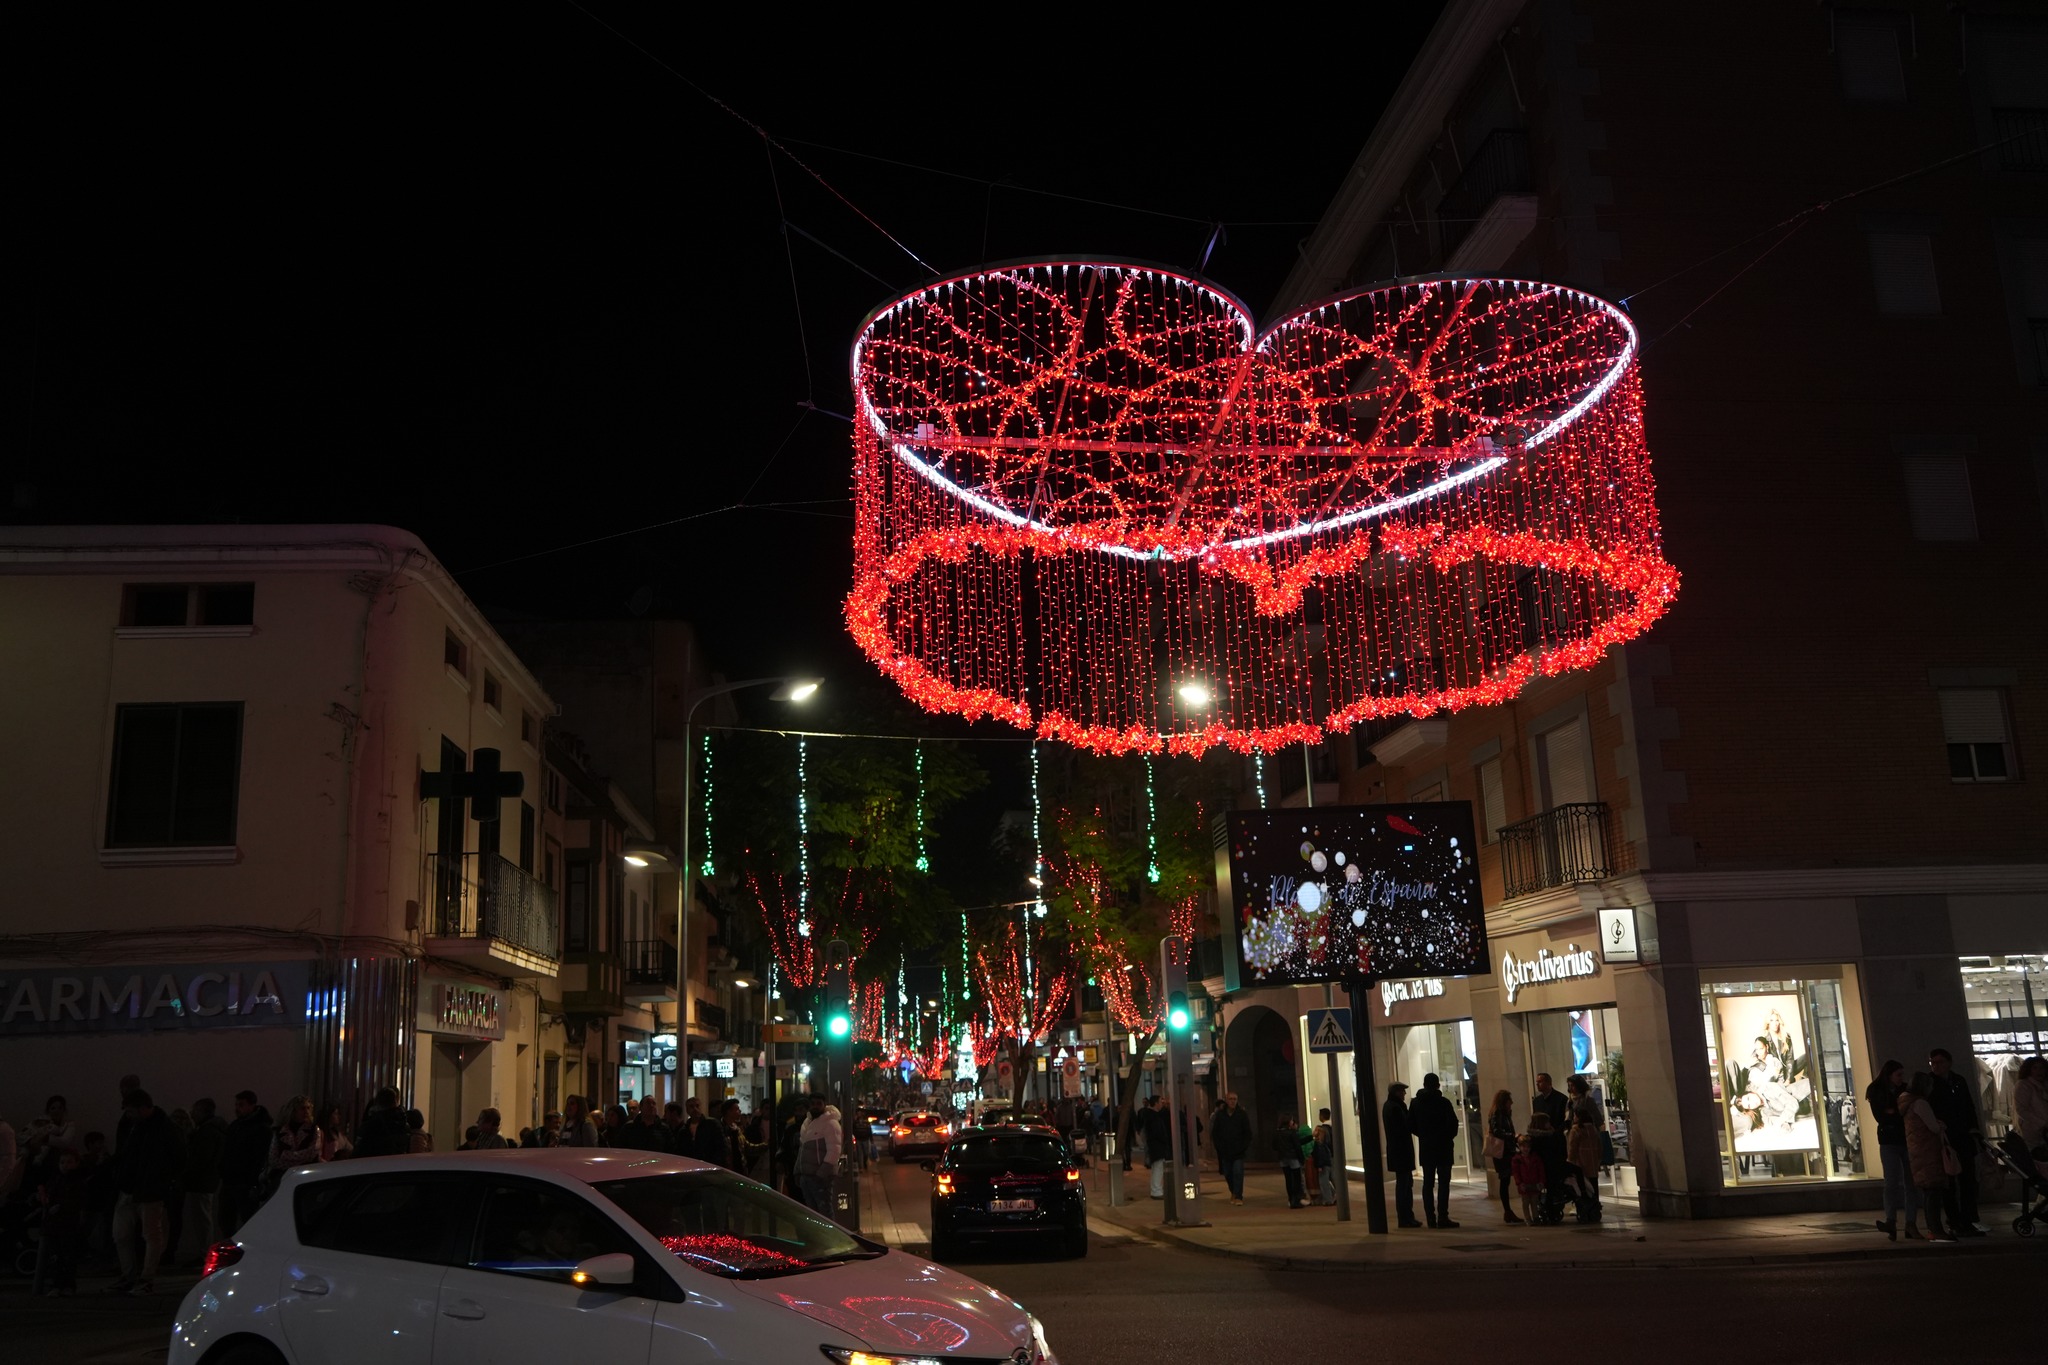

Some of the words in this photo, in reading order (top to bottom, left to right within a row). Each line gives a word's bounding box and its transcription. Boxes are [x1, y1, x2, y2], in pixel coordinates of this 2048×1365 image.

[1271, 874, 1330, 911] Pla
[1370, 870, 1438, 909] España
[1502, 943, 1594, 1003] Stradivarius
[0, 971, 285, 1023] ARMACIA
[443, 984, 499, 1030] FARMACIA
[1381, 978, 1443, 1017] Stradvaius
[991, 1201, 1013, 1210] 7134
[1017, 1200, 1033, 1209] JML
